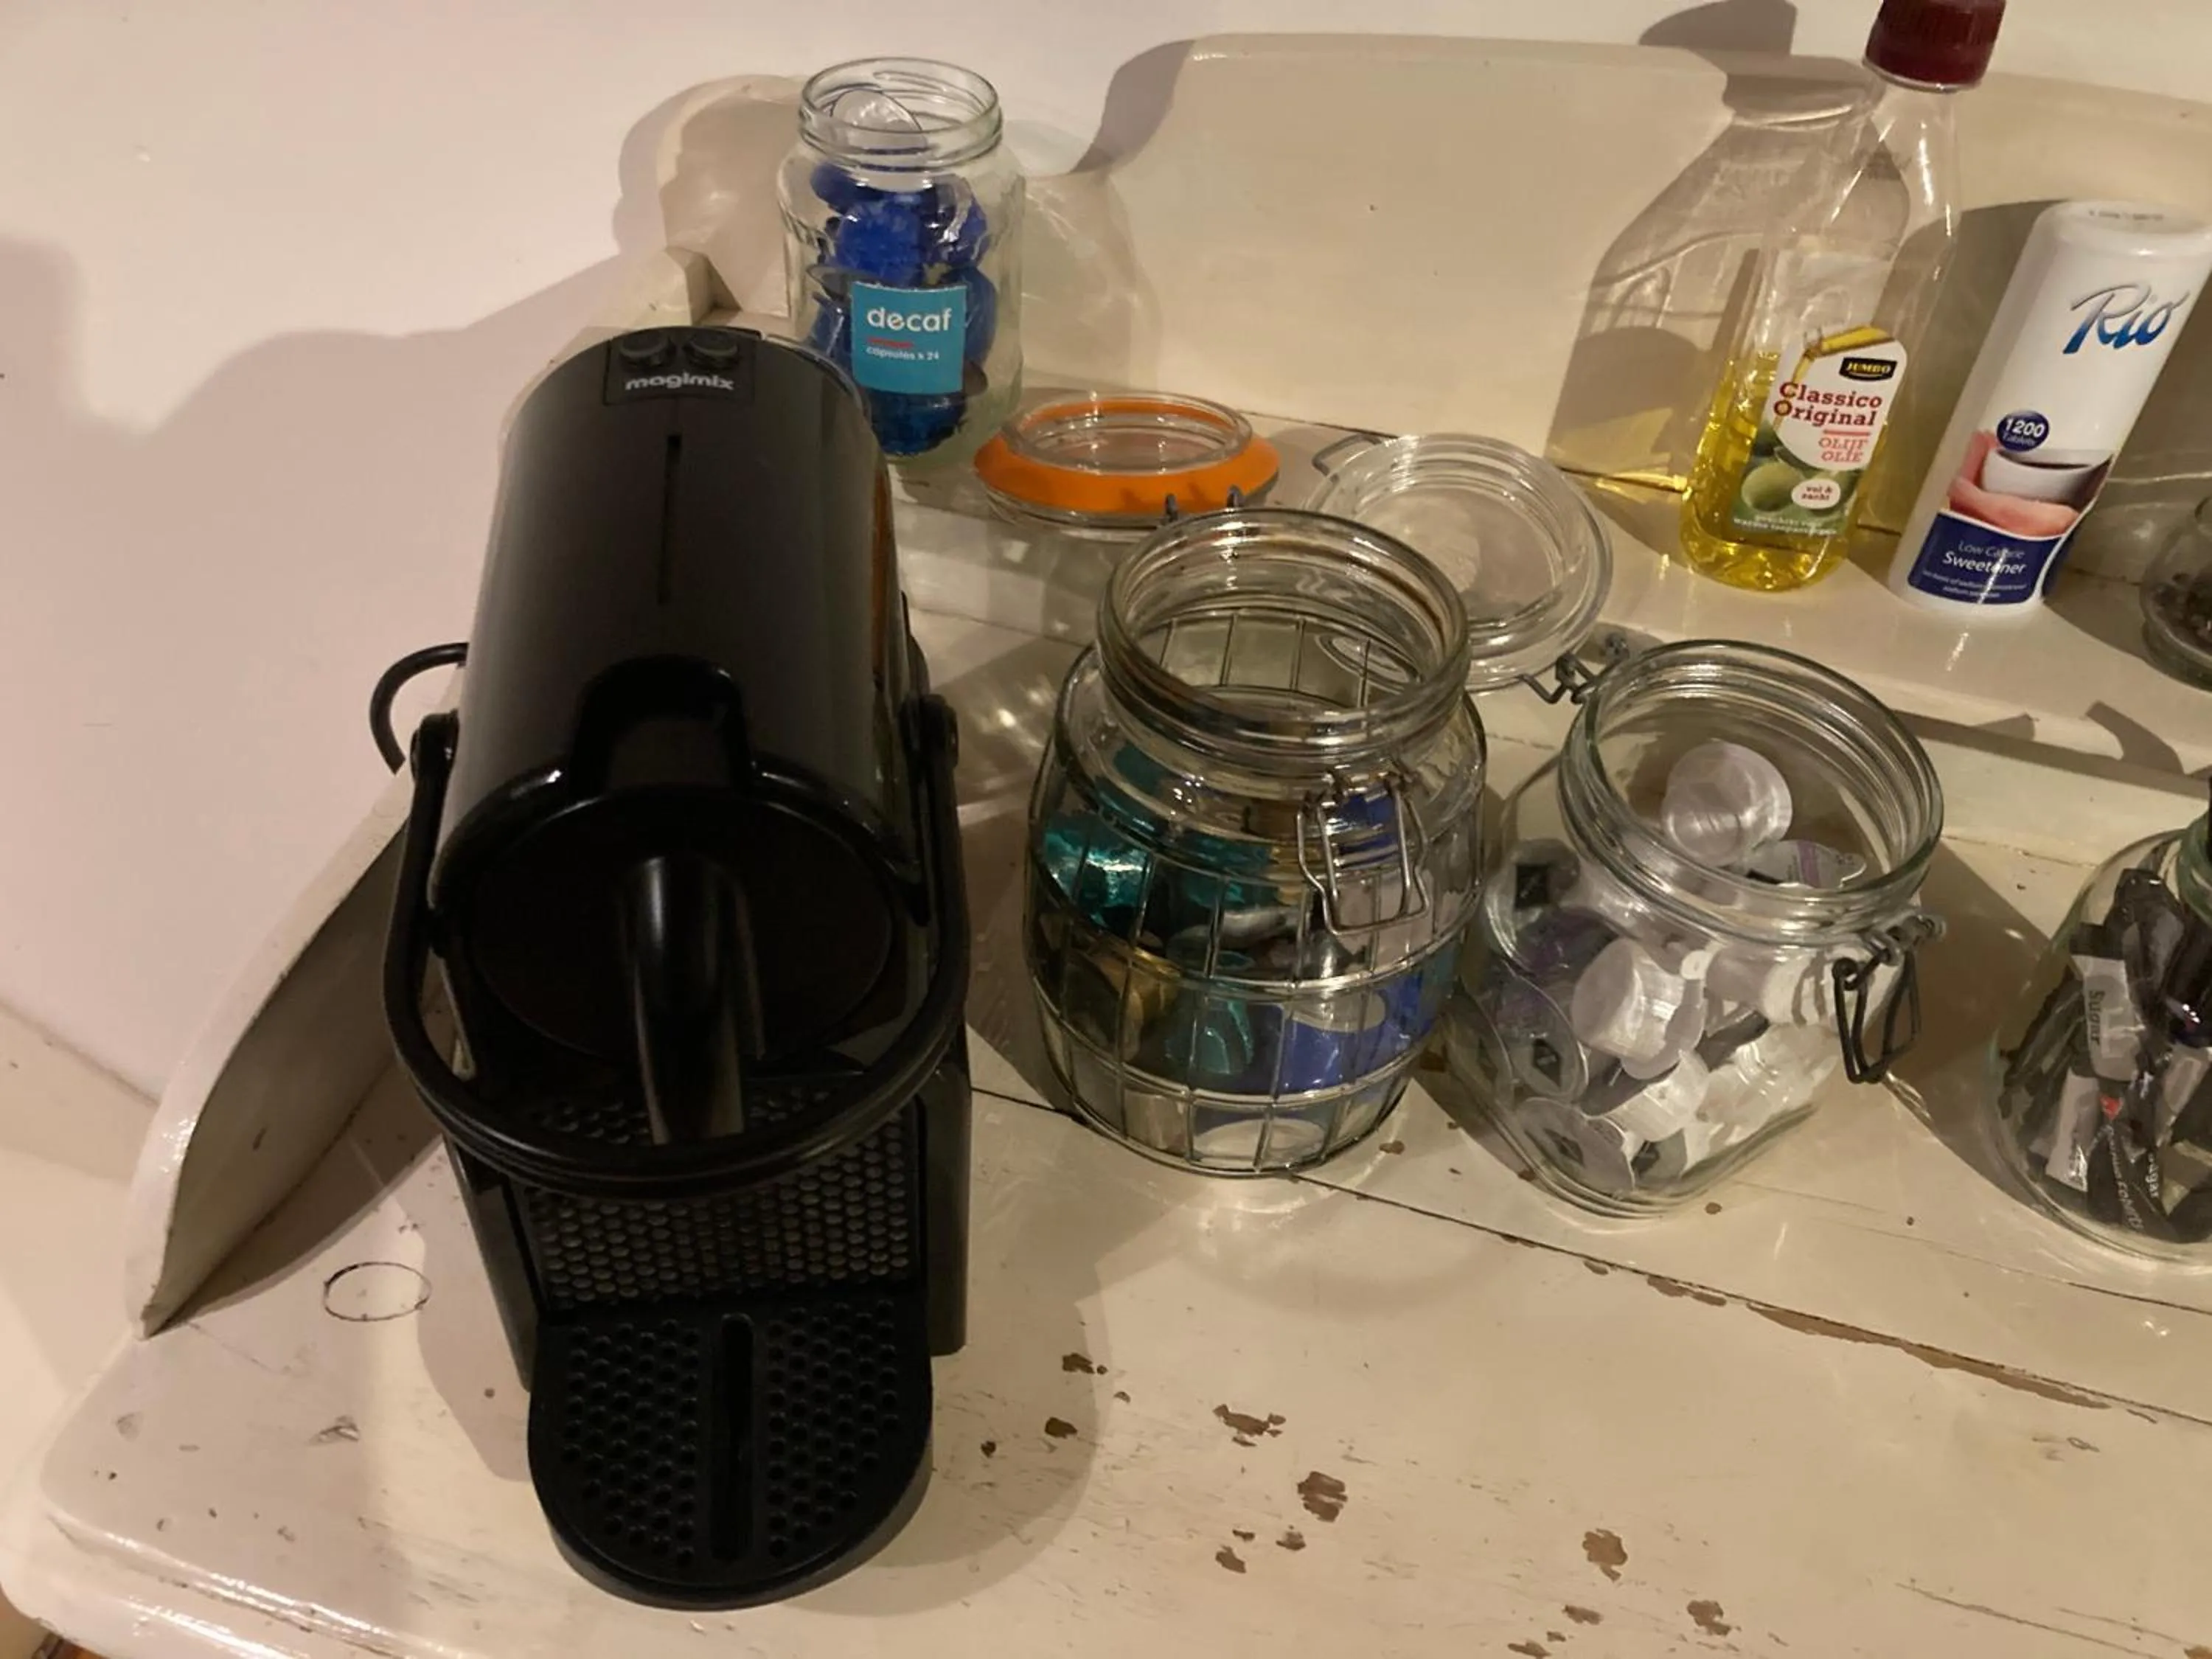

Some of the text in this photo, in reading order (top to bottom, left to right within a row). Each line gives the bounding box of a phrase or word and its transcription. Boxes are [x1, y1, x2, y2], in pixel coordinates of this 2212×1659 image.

[866, 307, 953, 332] decaf
[2062, 284, 2190, 355] Rio
[1846, 362, 1891, 374] JUMBO
[625, 372, 734, 391] magimix
[1779, 382, 1882, 408] Classico
[1773, 400, 1877, 428] Original
[2006, 418, 2046, 437] 1200
[1820, 451, 1863, 463] OLIE
